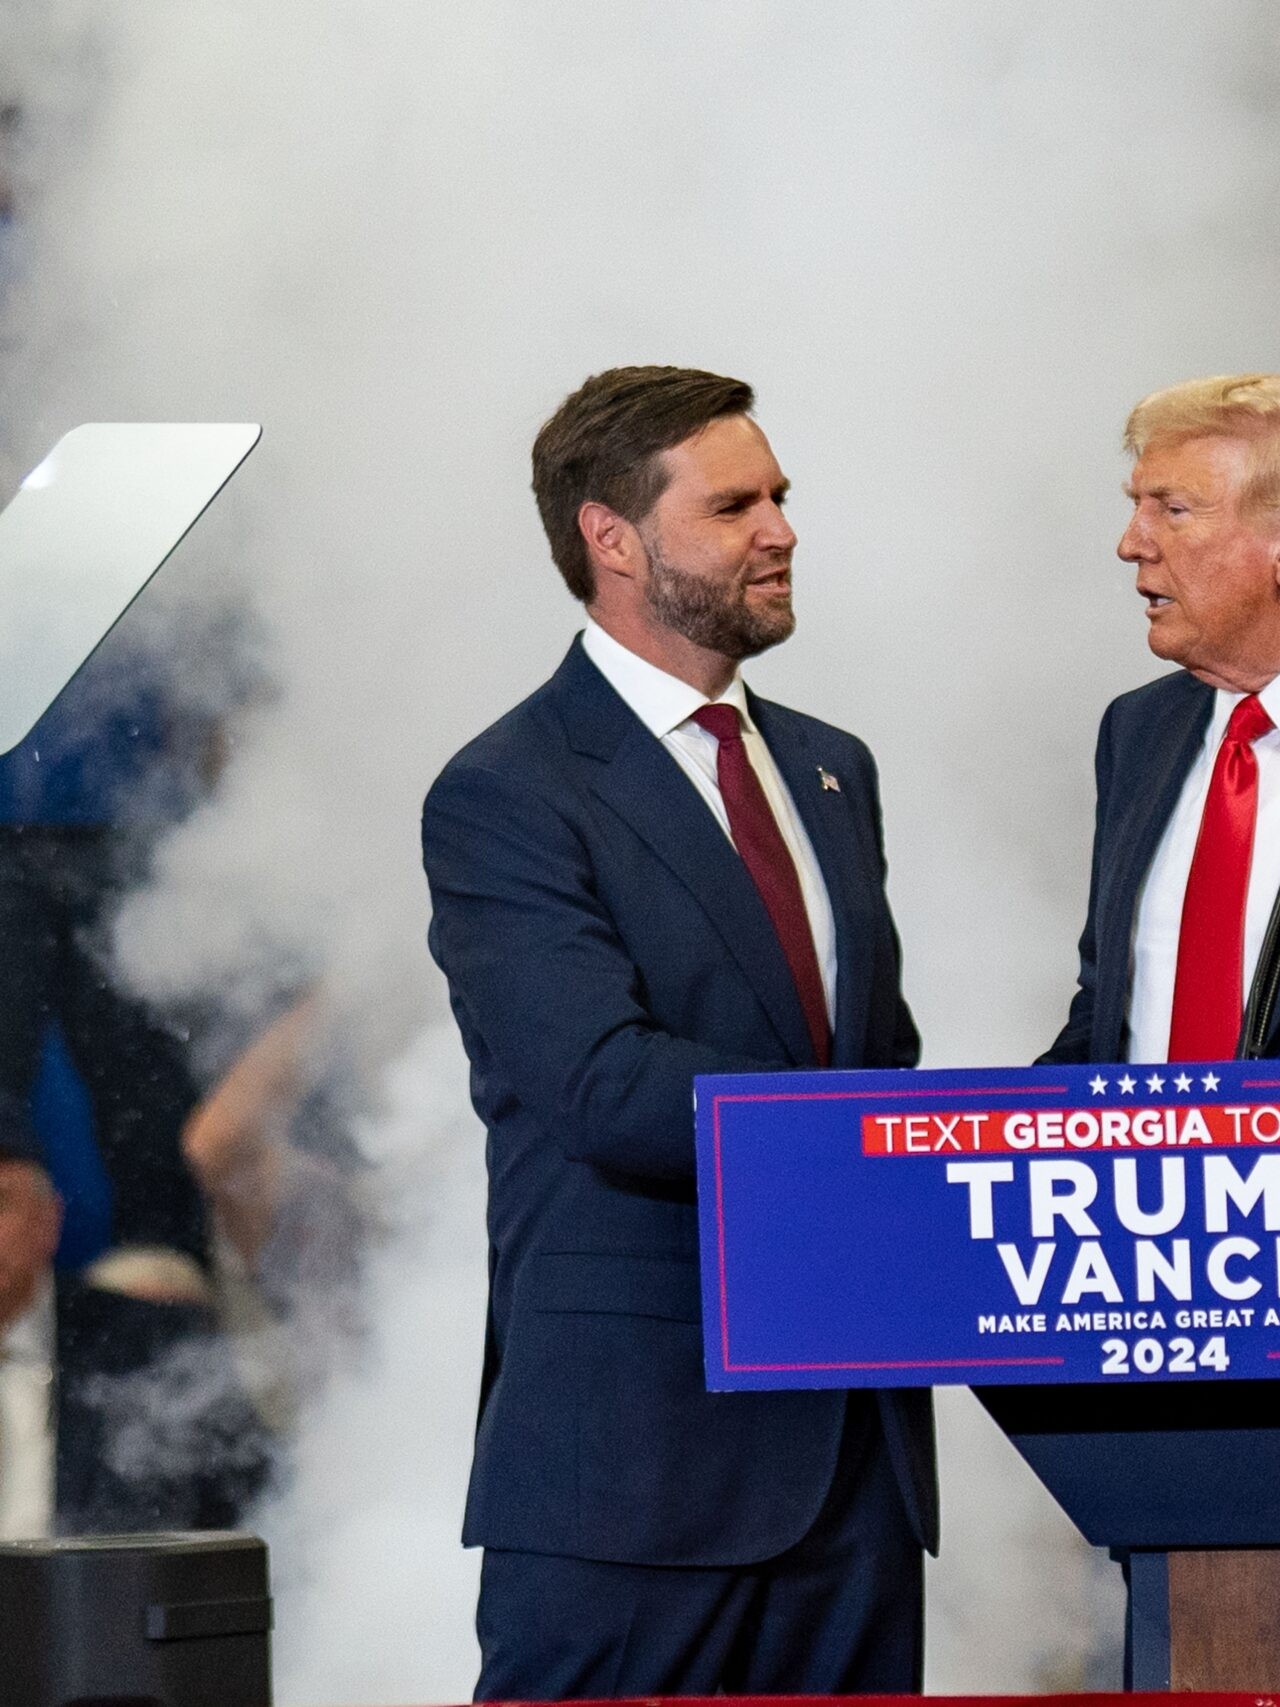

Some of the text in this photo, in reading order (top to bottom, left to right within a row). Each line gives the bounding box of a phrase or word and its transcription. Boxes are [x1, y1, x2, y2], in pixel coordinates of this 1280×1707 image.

[875, 1114, 989, 1153] TEXT
[1003, 1107, 1213, 1150] GEORGIA
[977, 1313, 1047, 1334] MAKE
[1055, 1310, 1167, 1332] AMERICA
[1174, 1308, 1255, 1329] GREAT
[1101, 1335, 1230, 1375] 2024
